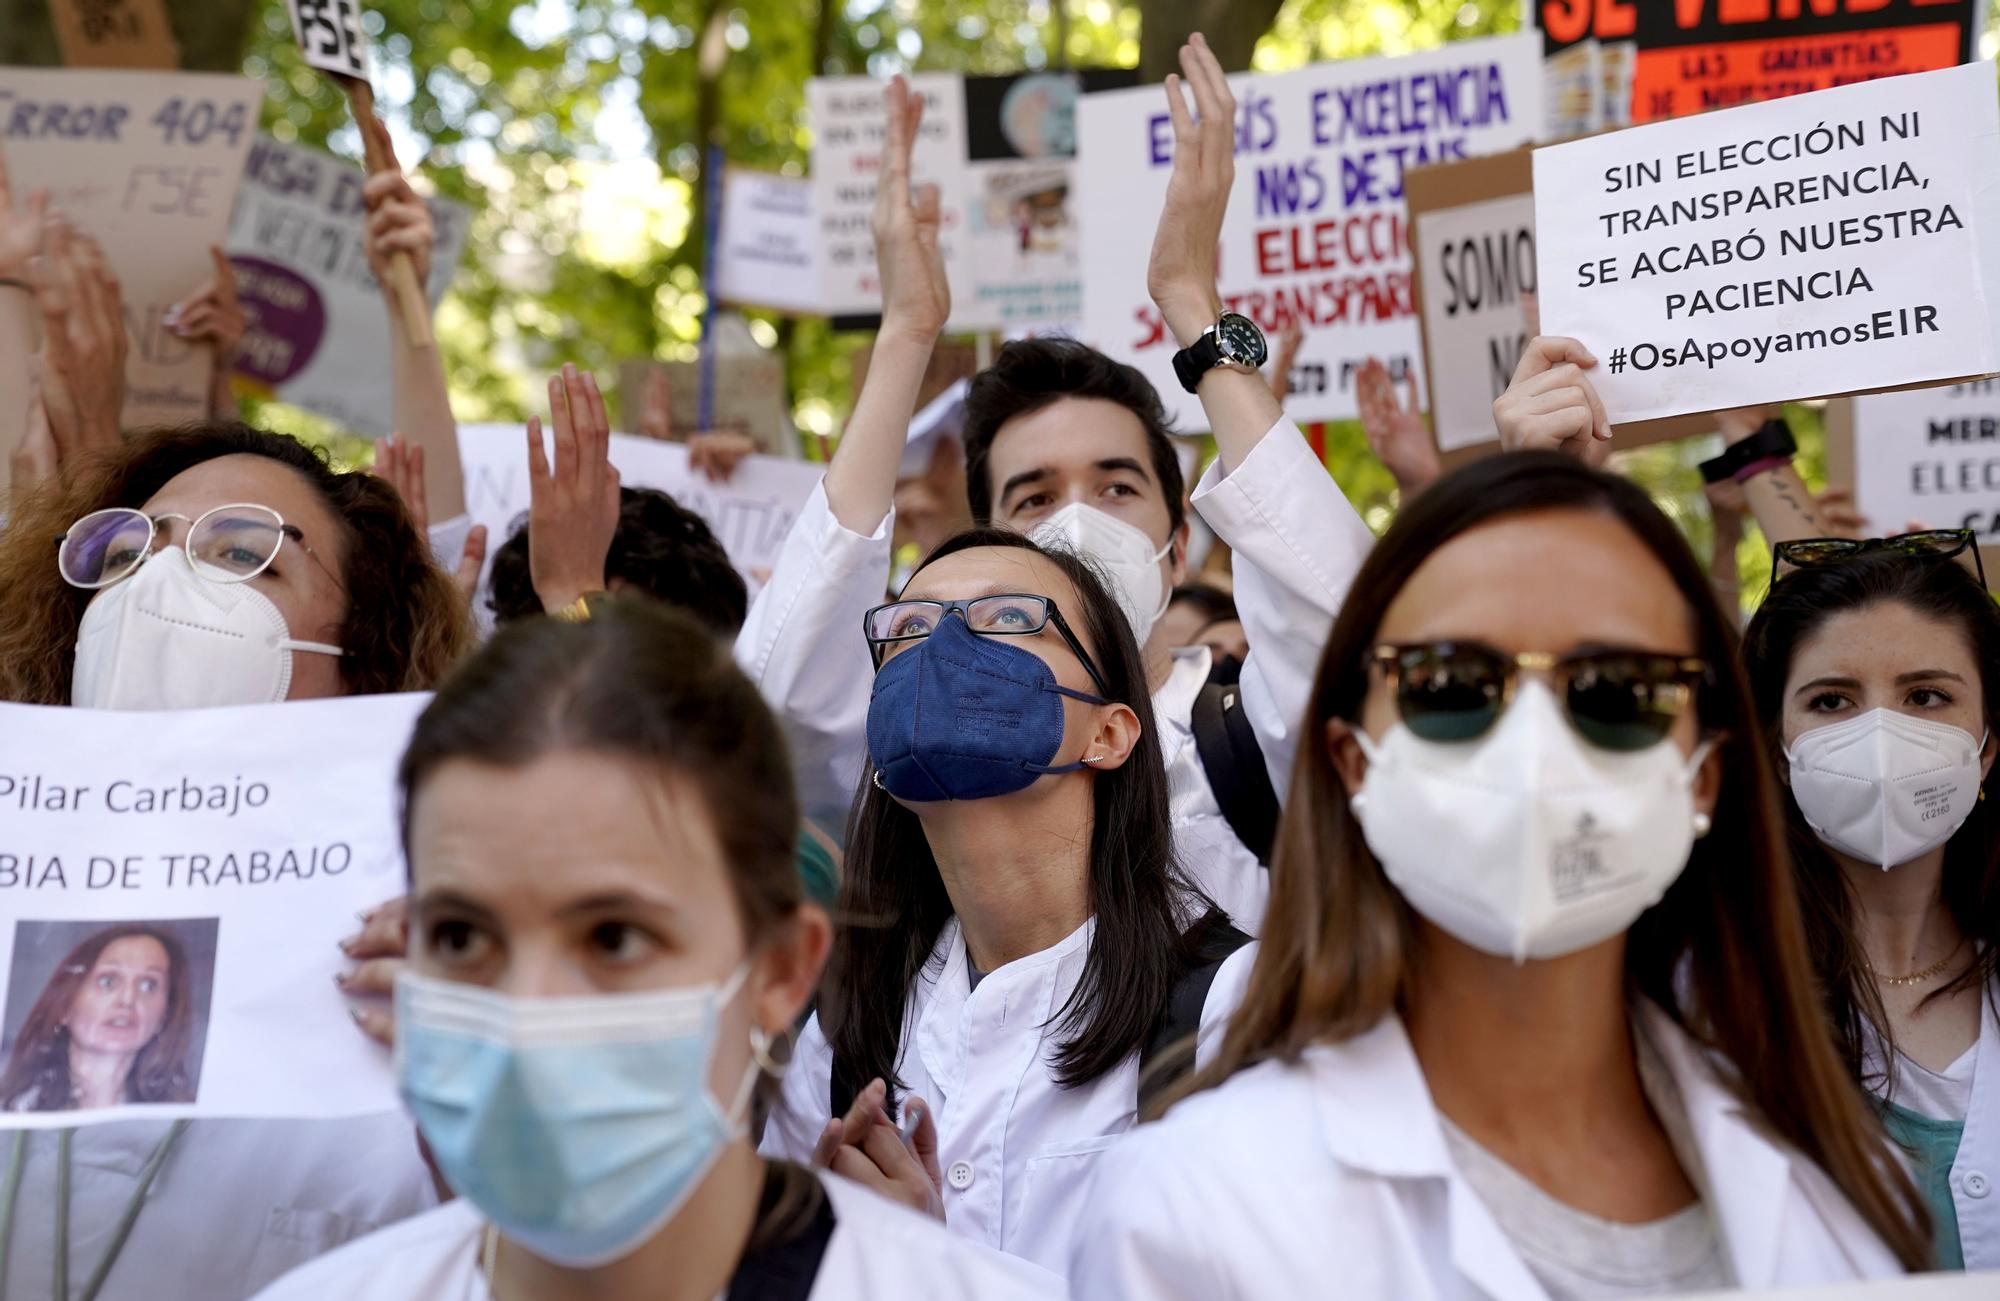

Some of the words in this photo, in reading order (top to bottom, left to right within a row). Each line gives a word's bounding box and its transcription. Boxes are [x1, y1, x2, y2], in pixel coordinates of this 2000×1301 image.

[0, 91, 129, 142] RROR
[151, 99, 246, 147] 404
[1147, 90, 1277, 168] EÍS
[1312, 64, 1508, 145] EXCELENCIA
[1605, 159, 1661, 193] SIN
[1676, 121, 1865, 179] ELECCIÓN
[1881, 111, 1920, 142] NI
[1256, 158, 1326, 217] NOS
[1599, 161, 1931, 238] TRANSPARENCIA,
[1577, 257, 1619, 288] SE
[1631, 228, 1766, 280] ACABÓ
[1780, 204, 1964, 256] NUESTRA
[1666, 266, 1874, 320] PACIENCIA
[1608, 305, 1940, 375] #OsApoyamosEIR
[0, 775, 90, 811] Pilar
[105, 776, 270, 817] Carbajo
[86, 857, 144, 889] DE
[160, 842, 352, 888] TRABAJO
